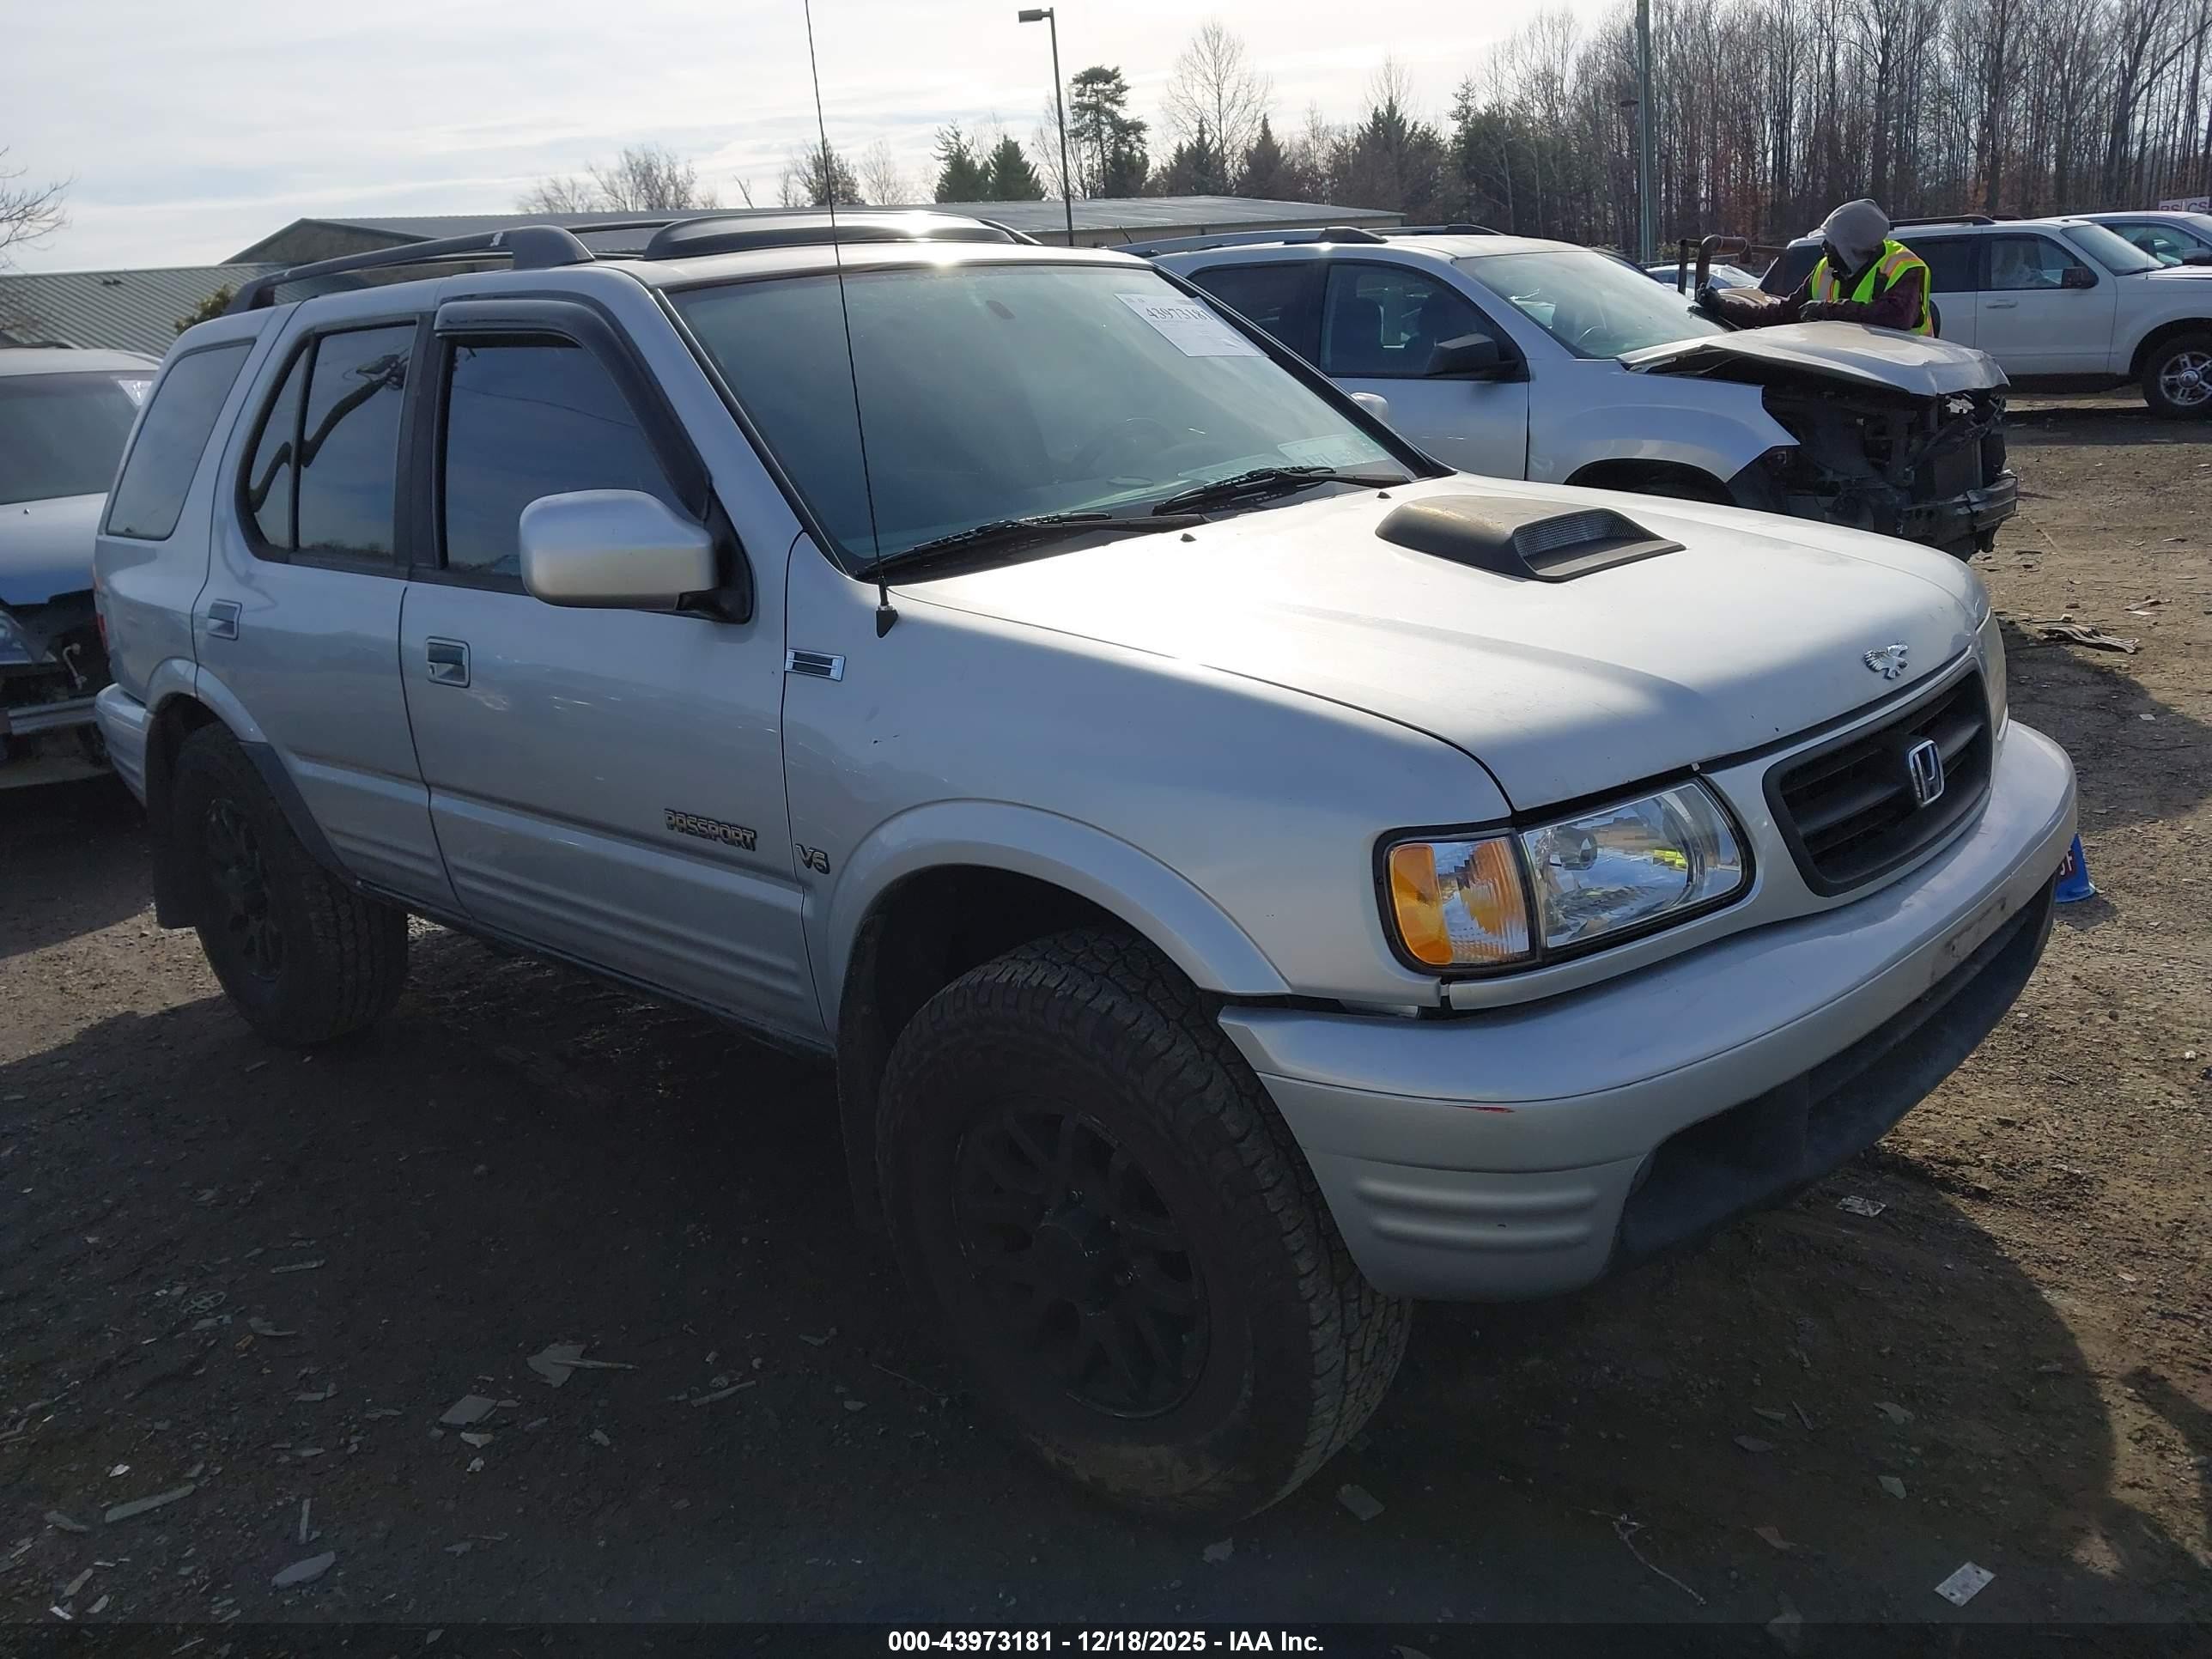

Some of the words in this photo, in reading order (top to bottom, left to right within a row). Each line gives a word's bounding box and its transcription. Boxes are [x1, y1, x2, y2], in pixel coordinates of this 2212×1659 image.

[1146, 307, 1215, 321] 43973181
[665, 809, 758, 851] PASSPORT
[795, 842, 831, 874] V6
